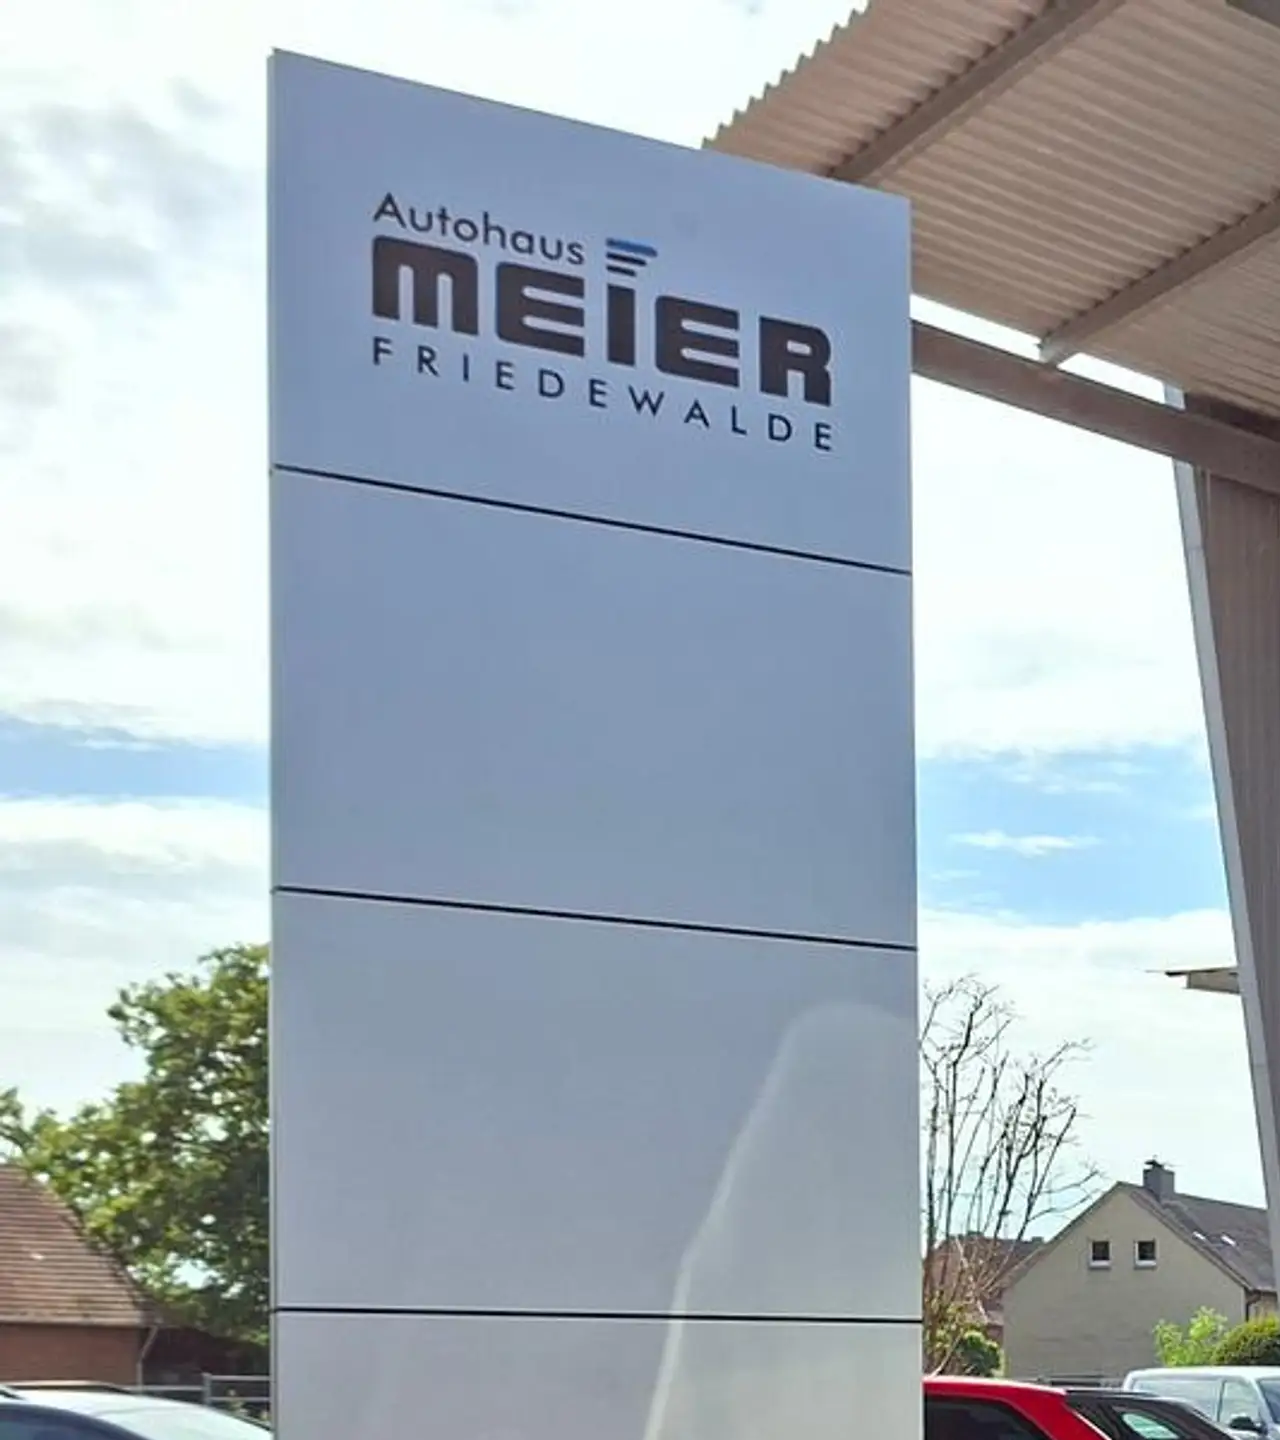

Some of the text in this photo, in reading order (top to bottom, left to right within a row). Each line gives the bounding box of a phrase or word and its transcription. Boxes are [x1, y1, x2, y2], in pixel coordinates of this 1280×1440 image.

[372, 192, 586, 267] Autohaus
[371, 236, 832, 407] MEIER
[372, 337, 834, 452] FRIEDEWALDE
